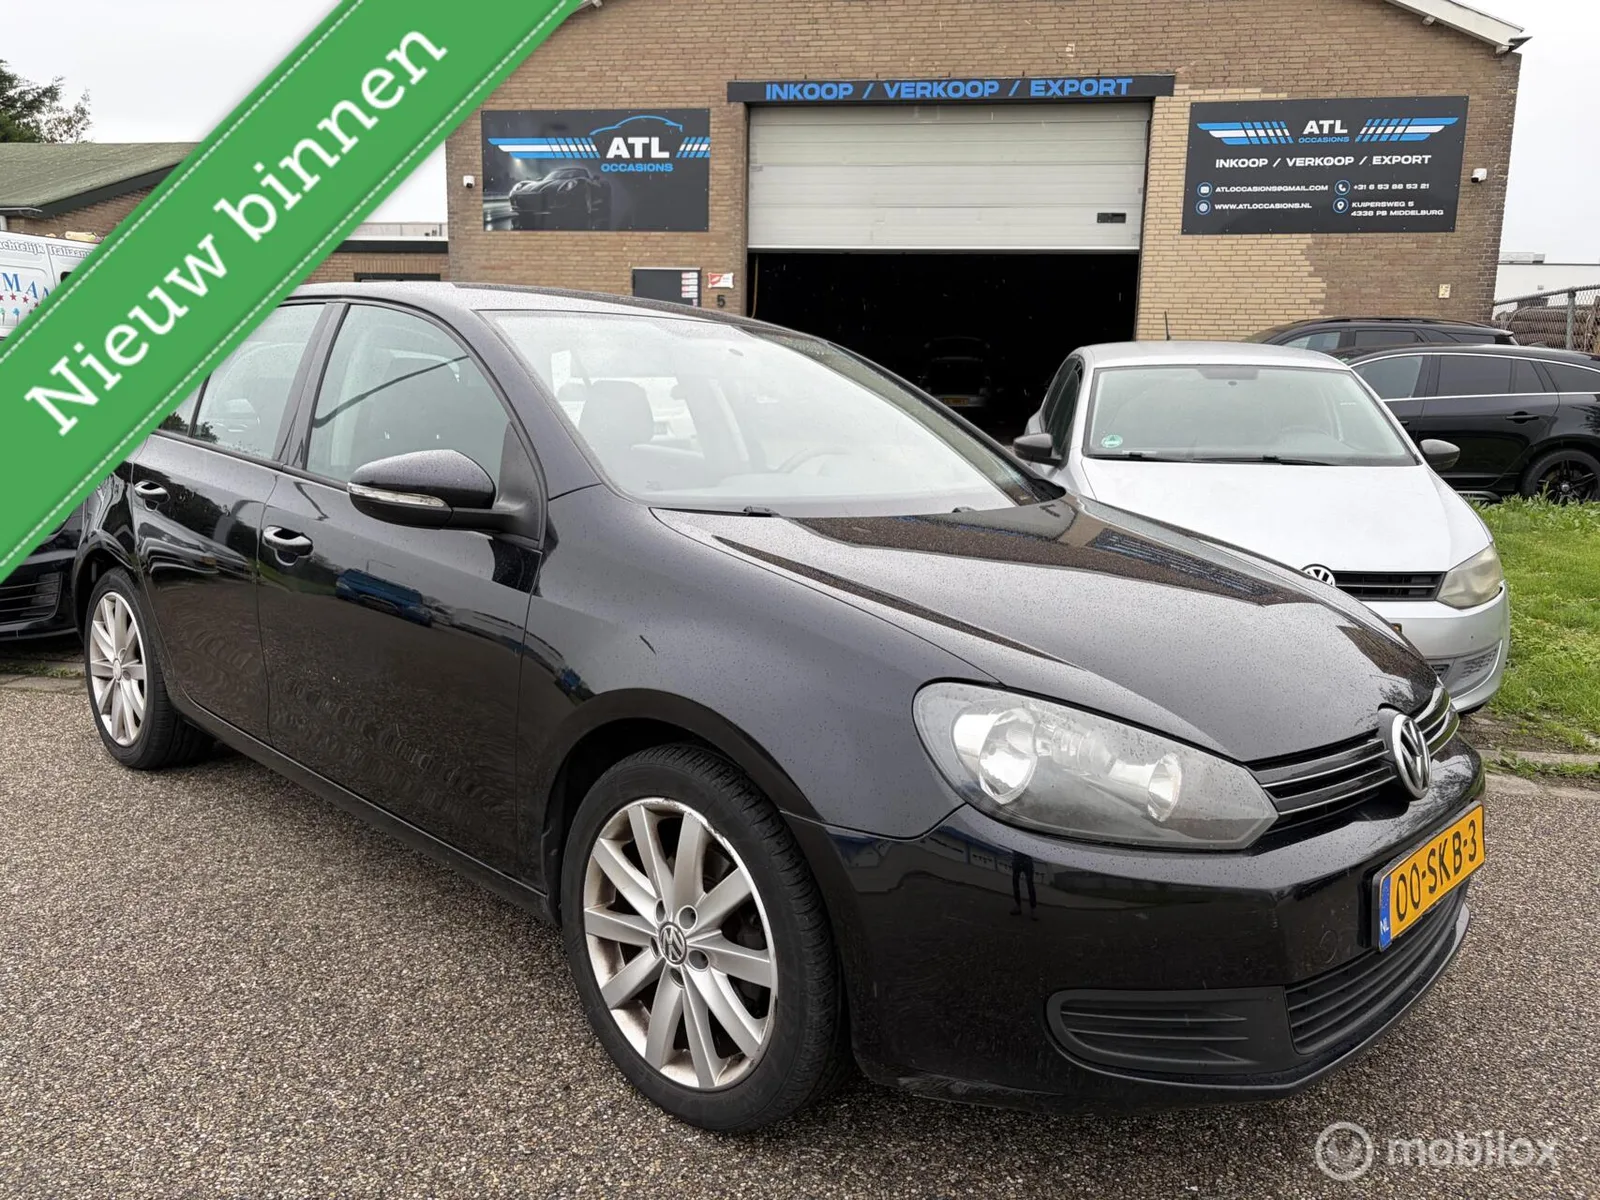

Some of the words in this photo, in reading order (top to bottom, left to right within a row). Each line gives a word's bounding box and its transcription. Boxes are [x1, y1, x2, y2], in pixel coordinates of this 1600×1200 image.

[765, 82, 854, 100] INKOOP
[862, 82, 874, 99] /
[883, 80, 999, 99] VERKOOP
[1008, 79, 1020, 97] /
[1030, 77, 1133, 97] EXPORT
[1303, 119, 1348, 135] ATL
[1298, 136, 1350, 144] OCCASIONS
[606, 136, 670, 159] ATL
[601, 163, 674, 173] OCCASIONS
[1215, 157, 1268, 169] INKOOP
[1286, 156, 1355, 168] VERKOOP
[1372, 154, 1432, 166] EXPORT
[1215, 184, 1329, 193] ATLOCCASIONS@GMAIL.COM
[1214, 202, 1312, 210] WWW.ATLOCCASIONS.NL
[1389, 209, 1444, 217] MIDDELBURG
[716, 294, 726, 308] 5
[1395, 819, 1478, 922] 00-SKB-3
[1379, 917, 1390, 936] NL
